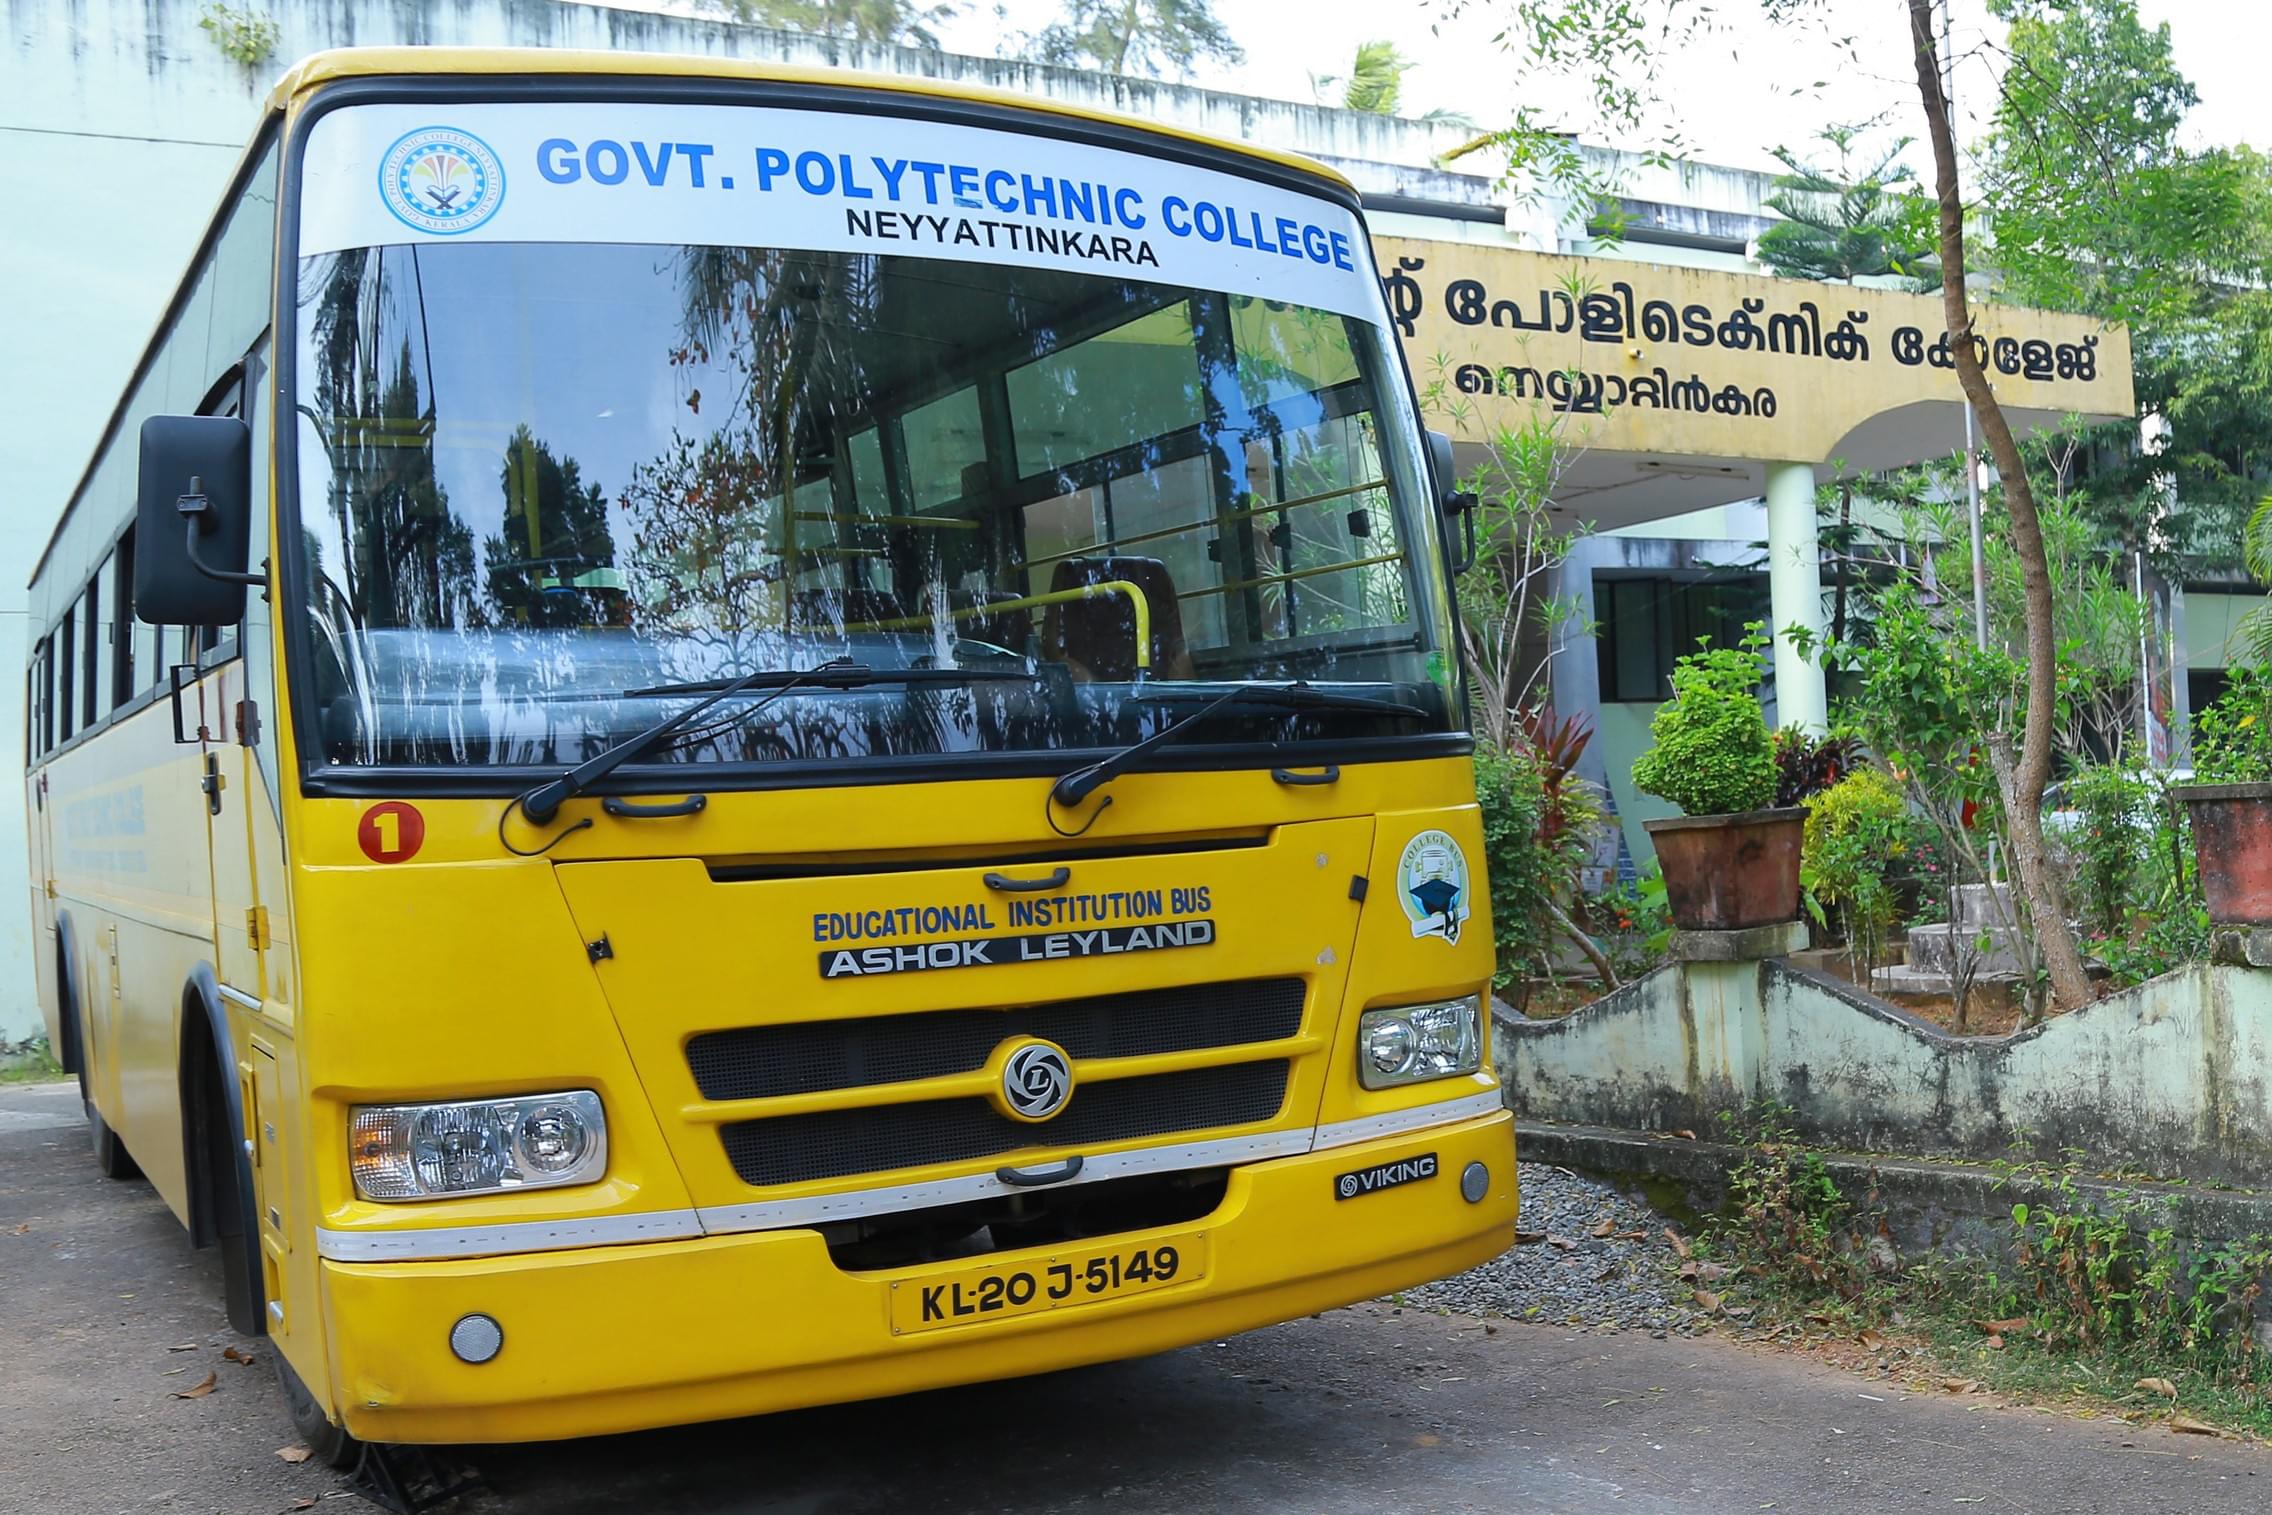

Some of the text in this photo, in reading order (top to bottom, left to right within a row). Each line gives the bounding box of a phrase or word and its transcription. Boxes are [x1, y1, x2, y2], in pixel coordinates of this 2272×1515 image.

[423, 133, 474, 147] COLLEGE
[536, 138, 1355, 273] GOVT. POLYTECHNIC COLLEGE
[847, 208, 1160, 268] NEYYATTINKARA
[373, 812, 400, 853] 1
[1403, 834, 1445, 869] COLLEGE
[813, 886, 1211, 942] EDUCATIONAL INSTITUTION BUS
[827, 920, 1212, 977] ASHOK LEYLAND
[1028, 1069, 1049, 1090] L
[1360, 1157, 1435, 1190] VIKING
[922, 1246, 1180, 1322] KL-20 J-5149
